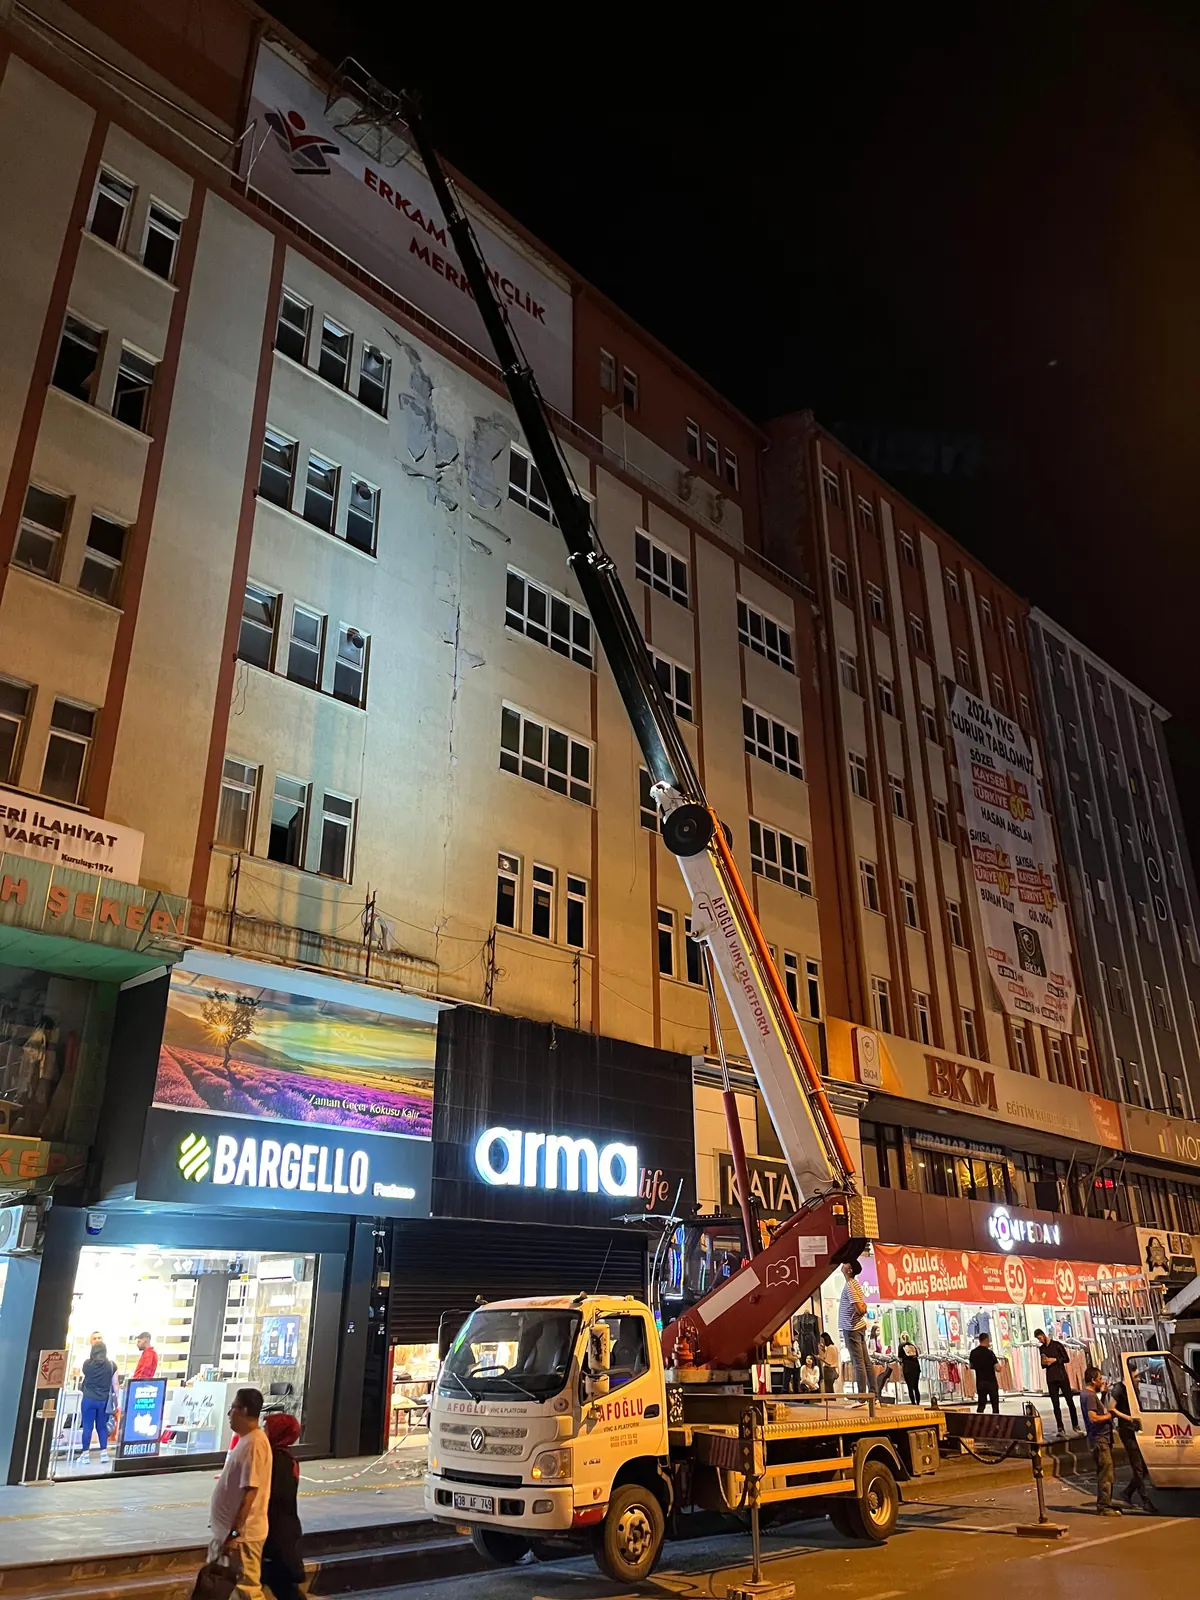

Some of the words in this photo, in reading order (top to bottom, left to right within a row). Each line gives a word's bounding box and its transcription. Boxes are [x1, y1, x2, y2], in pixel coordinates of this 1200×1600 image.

[364, 167, 447, 248] ERKAM
[966, 696, 993, 730] 2024
[993, 713, 1015, 744] YKS
[970, 747, 996, 769] SÖZEL
[973, 784, 1008, 809] TÜRKİYE
[3, 824, 60, 851] VAKFI
[32, 811, 118, 848] İLAHİYAT
[981, 806, 1006, 830] HASAN
[1007, 820, 1033, 844] ARSLAN
[47, 885, 187, 937] ŞEKERİ
[711, 896, 737, 939] AFOĞLU
[728, 939, 745, 970] VİNÇ
[739, 969, 771, 1037] PLATFORM
[863, 1068, 878, 1081] BKM
[923, 1053, 999, 1113] BKM
[308, 1094, 341, 1108] Zaman
[369, 1103, 400, 1117] Kokusu
[1006, 1100, 1035, 1121] EĞİTİM
[212, 1134, 369, 1195] BARGELLO
[475, 1126, 638, 1197] arma
[638, 1167, 669, 1210] life
[902, 1251, 940, 1274] Okula
[896, 1275, 929, 1298] Dönüş
[929, 1270, 968, 1296] Başladı
[447, 1401, 487, 1414] AFOĞLU
[599, 1397, 643, 1422] AFOĞLU
[618, 1421, 640, 1430] PLATFORM
